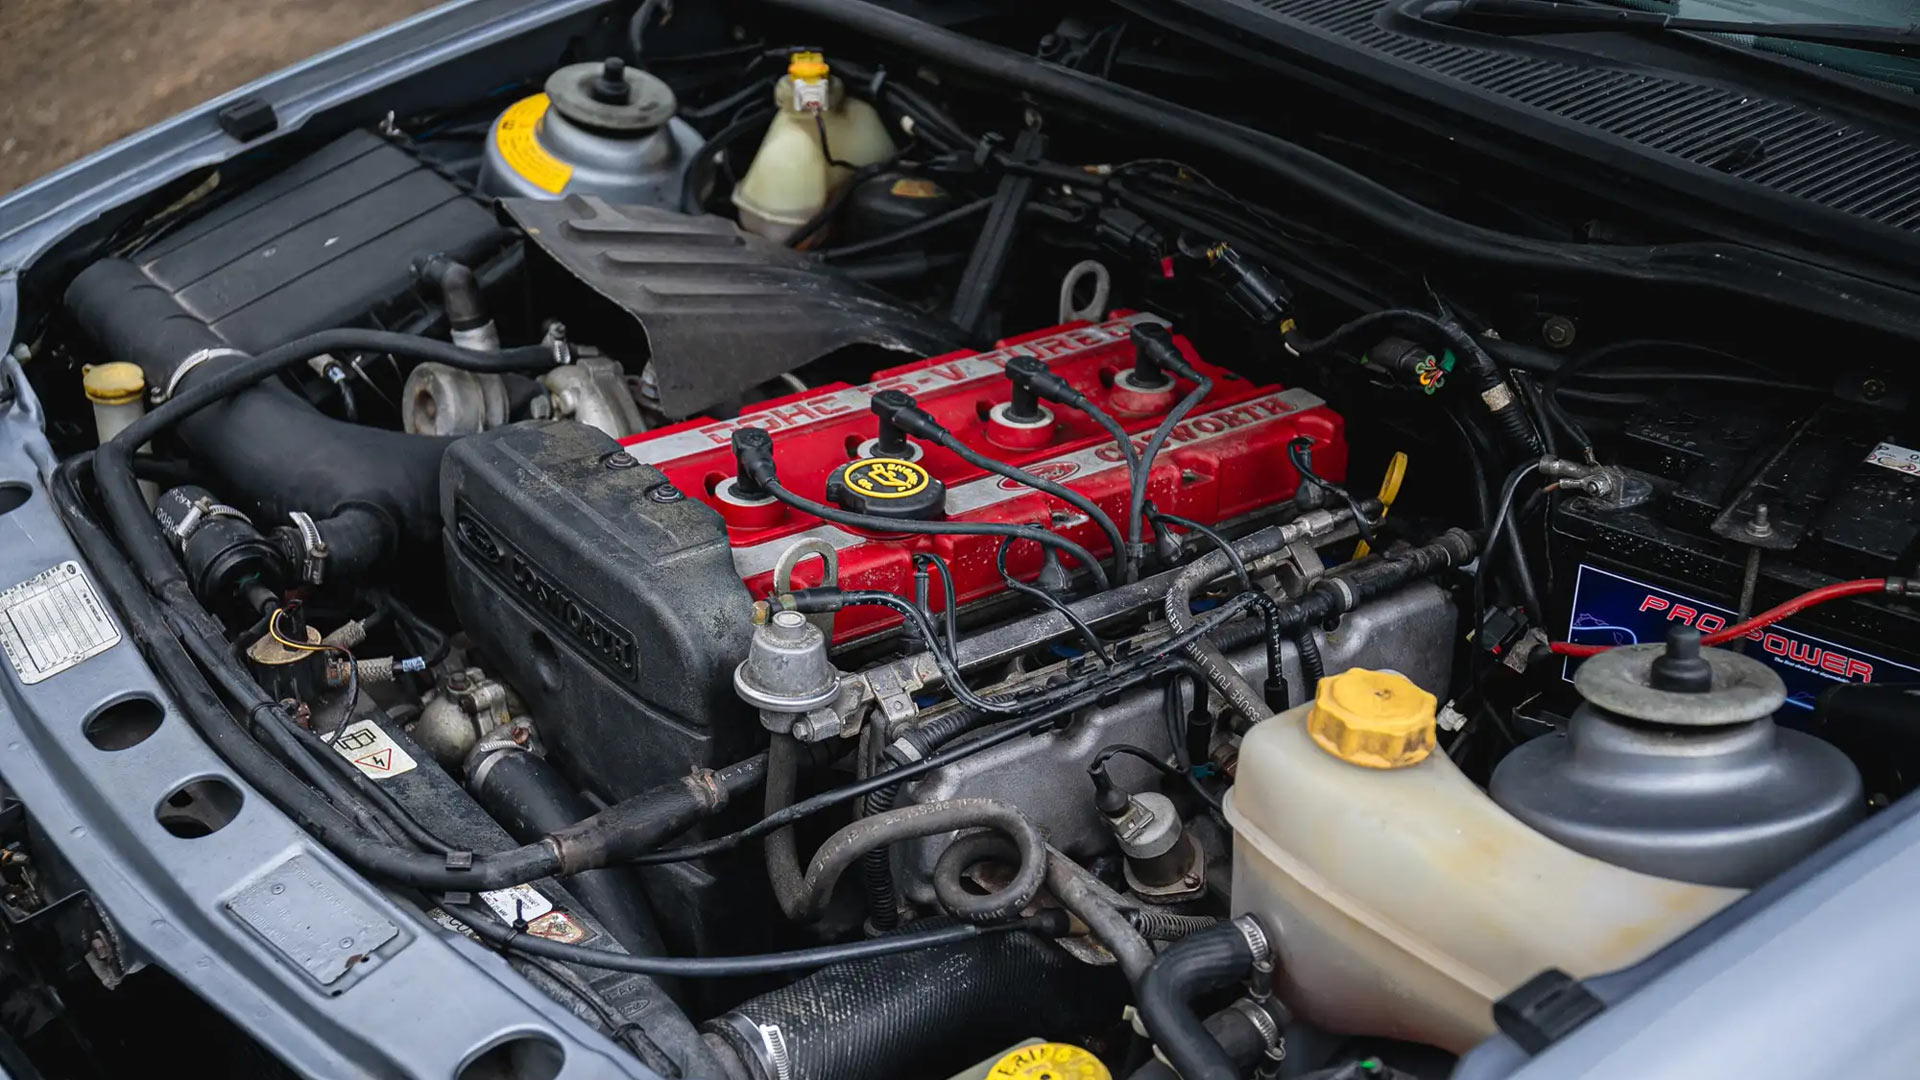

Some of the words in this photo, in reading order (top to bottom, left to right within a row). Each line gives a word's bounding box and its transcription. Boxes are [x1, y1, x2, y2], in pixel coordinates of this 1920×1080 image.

[1639, 594, 1726, 634] PRO
[1186, 641, 1209, 667] LINE
[1207, 664, 1231, 690] FUEL
[1229, 689, 1264, 725] SSURE
